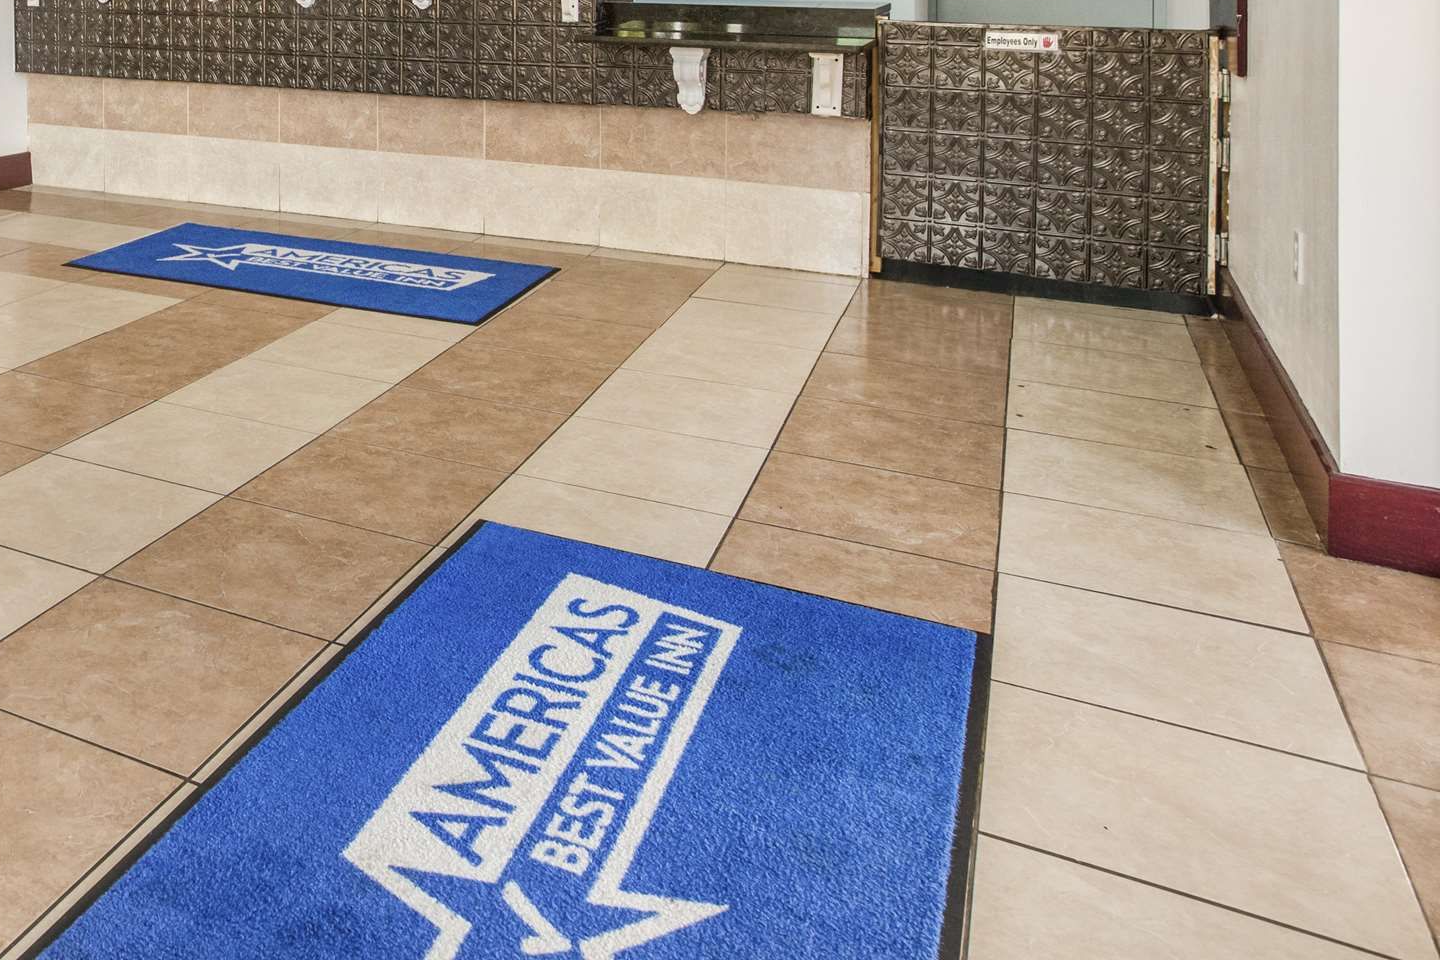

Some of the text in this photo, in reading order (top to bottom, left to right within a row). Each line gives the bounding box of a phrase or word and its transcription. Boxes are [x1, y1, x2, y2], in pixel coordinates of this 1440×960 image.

[987, 36, 1038, 48] Employees Only
[245, 256, 448, 287] BEST VALUE INN
[257, 248, 467, 280] AMERICAS
[408, 597, 640, 868] AMERICAS
[529, 621, 713, 877] BEST VALUE INN
